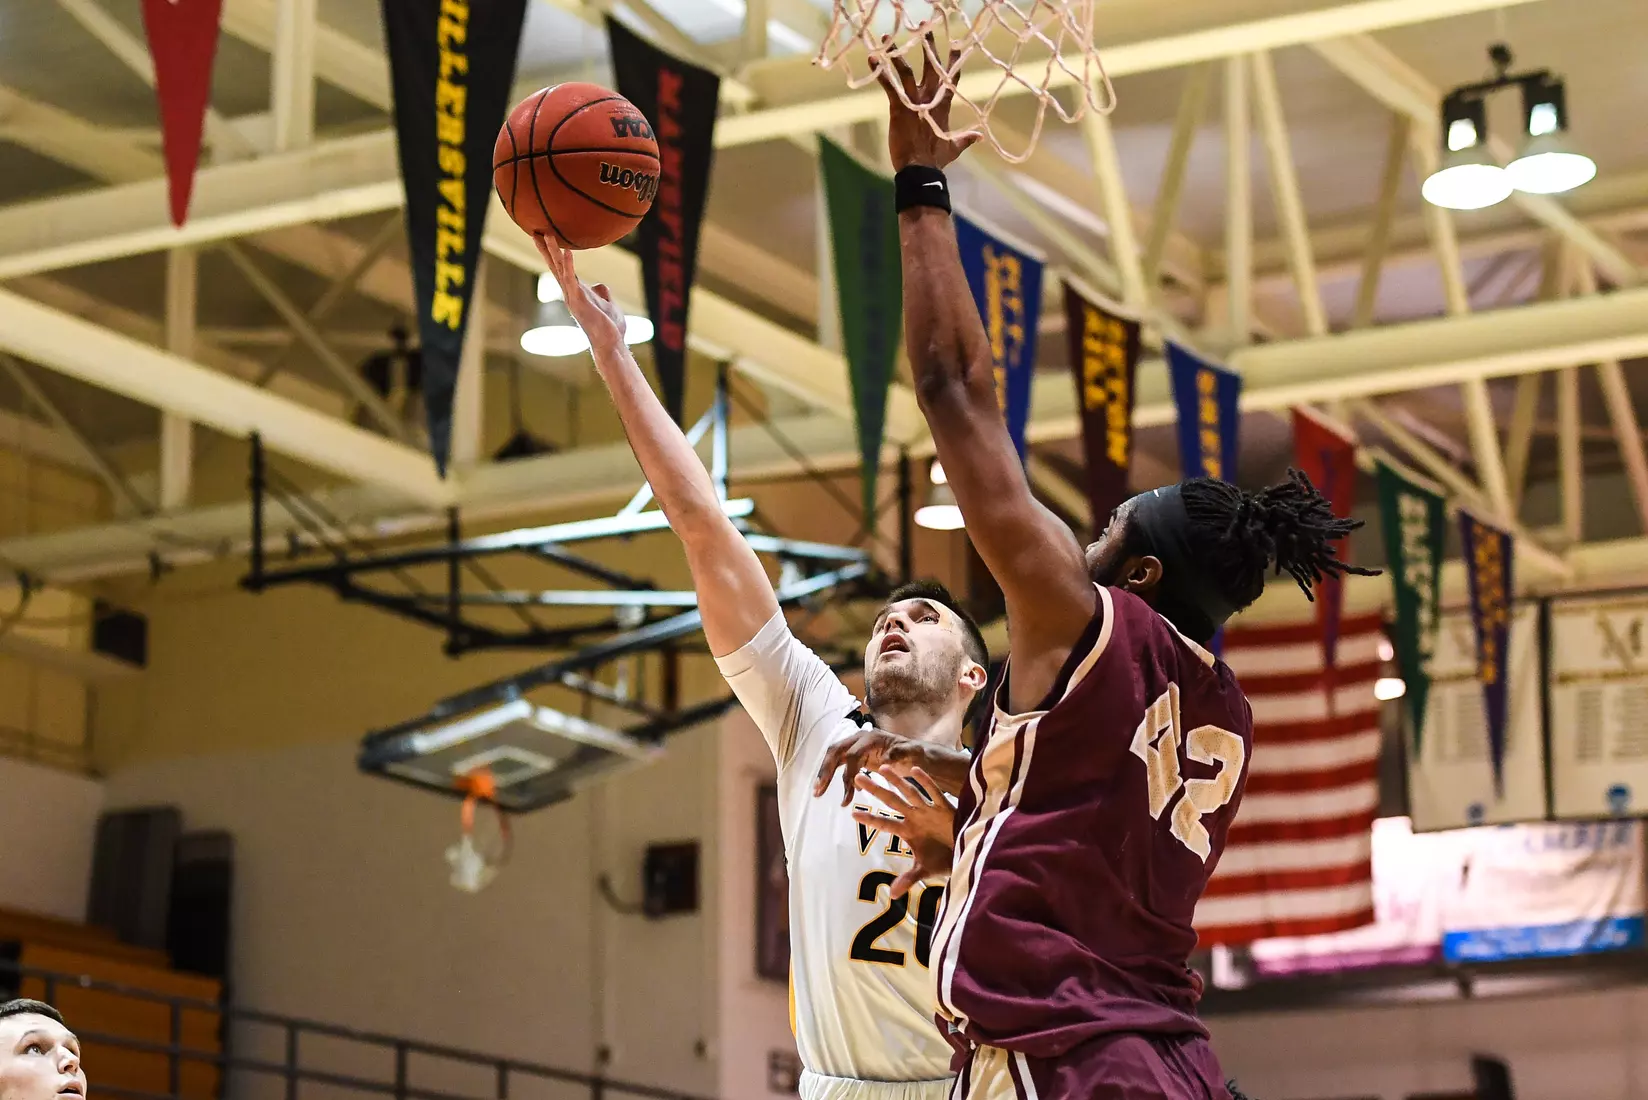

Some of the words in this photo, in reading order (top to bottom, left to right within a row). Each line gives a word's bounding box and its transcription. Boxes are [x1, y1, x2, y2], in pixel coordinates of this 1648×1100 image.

[431, 0, 469, 330] ILLERSVILLE
[609, 116, 655, 141] CAA
[1128, 681, 1245, 864] 42
[852, 803, 913, 858] VI
[848, 869, 946, 969] 20
